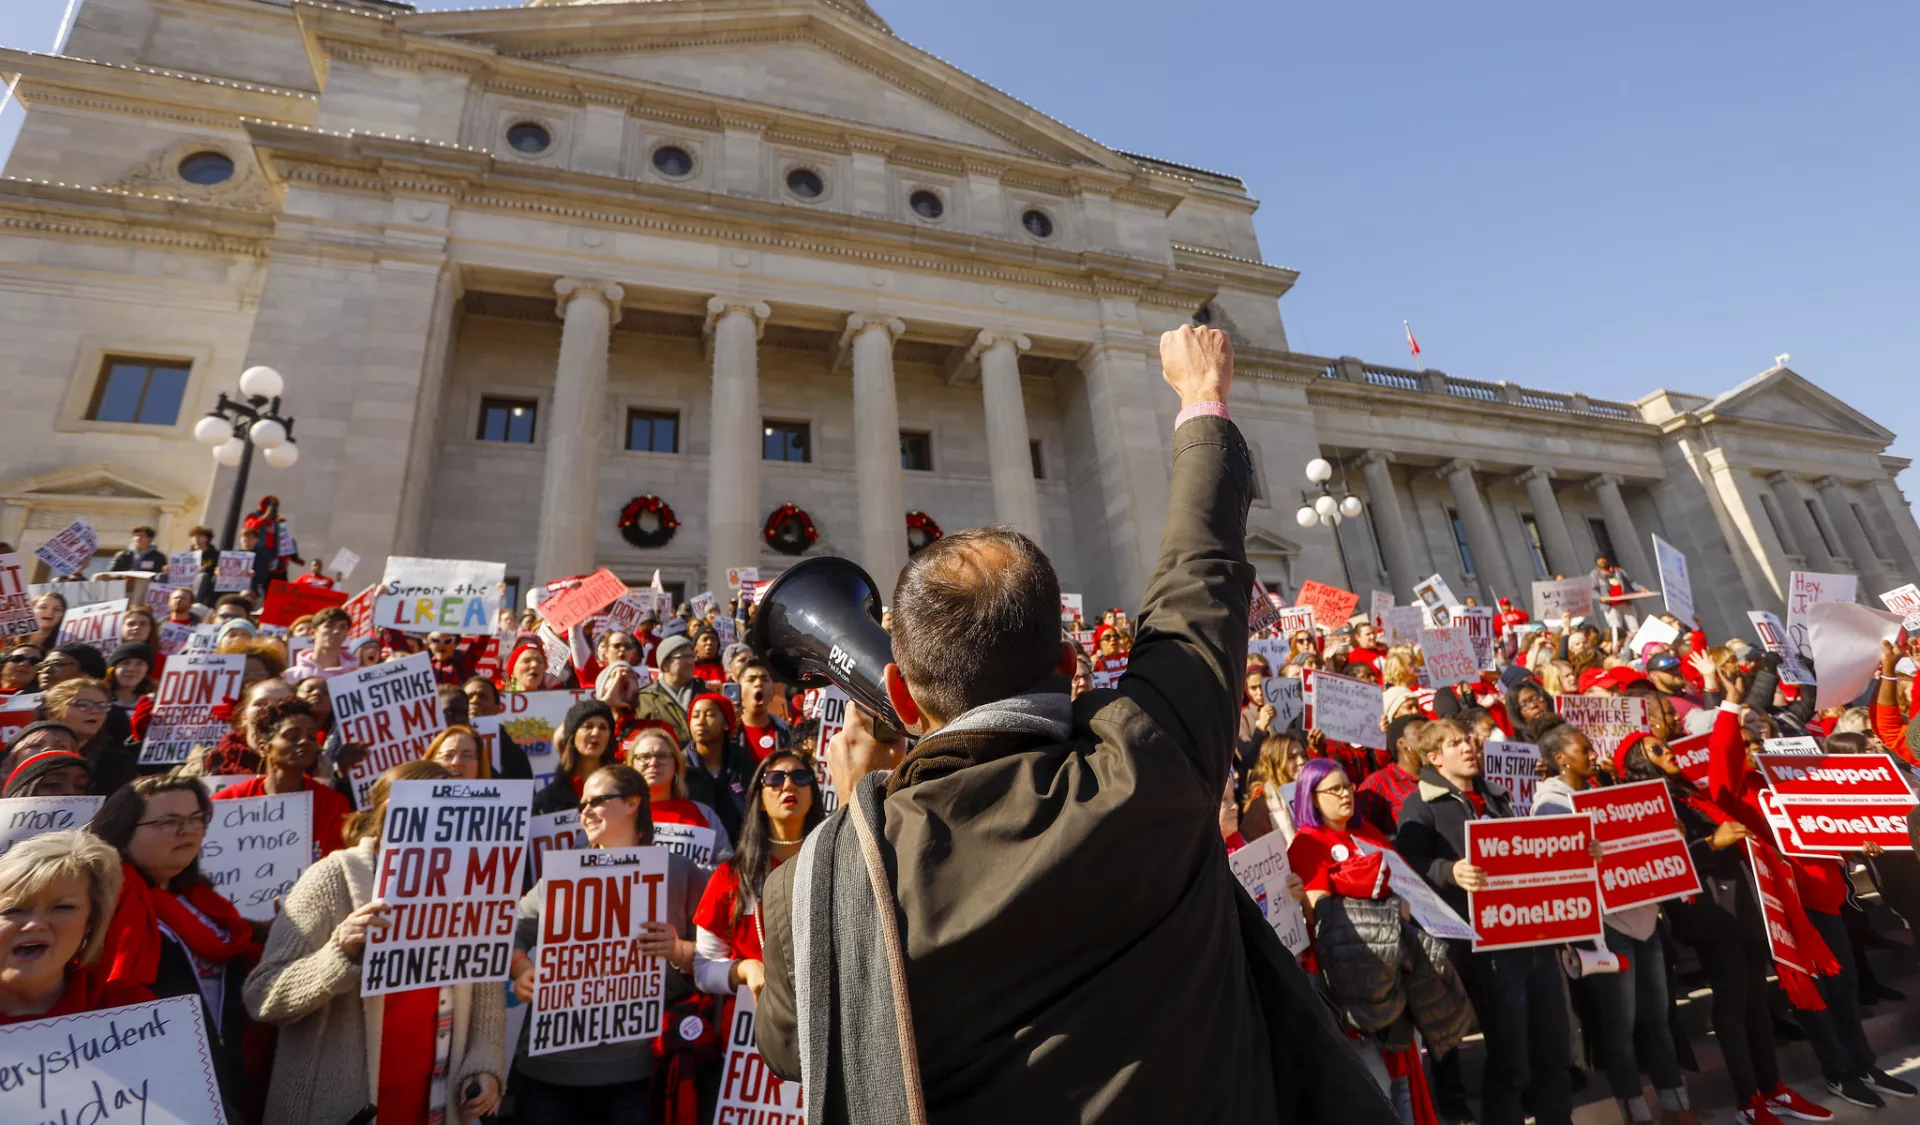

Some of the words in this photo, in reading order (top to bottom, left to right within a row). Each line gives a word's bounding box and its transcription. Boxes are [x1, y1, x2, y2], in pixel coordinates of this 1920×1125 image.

[455, 584, 488, 596] the
[394, 597, 488, 628] LREA
[1249, 609, 1281, 634] NELRSD
[1282, 613, 1314, 631] DON'T
[1432, 659, 1477, 681] VOICES
[160, 667, 241, 705] DON'T
[336, 689, 365, 719] ON
[368, 670, 436, 709] STRIKE
[1563, 697, 1631, 711] INJUSTICE
[1564, 709, 1632, 725] ANYWHERE
[342, 710, 396, 748] FOR
[399, 696, 439, 737] MY
[352, 729, 443, 780] STUDENT
[1486, 755, 1502, 774] ON
[1506, 756, 1539, 777] STRIK
[1770, 765, 1809, 781] We
[1809, 765, 1893, 786] Support
[432, 785, 472, 798] LREA
[9, 809, 76, 830] more
[223, 800, 285, 828] child
[1606, 796, 1666, 823] Support
[387, 807, 429, 843] ON
[435, 806, 528, 842] STRIKE
[1796, 815, 1910, 834] #OneLRS
[238, 829, 301, 852] more
[1478, 837, 1510, 858] We
[1512, 831, 1585, 859] Support
[255, 862, 275, 879] a
[378, 847, 453, 899] FOR
[463, 846, 524, 897] MY
[580, 854, 616, 868] LREA
[1602, 855, 1688, 892] #OneLRSD
[371, 900, 516, 944] STUDENTS
[543, 871, 665, 945] DON'T
[1481, 896, 1593, 929] #OneLRSD
[1769, 919, 1797, 950] #One
[366, 942, 510, 991] #ONELRSD
[537, 982, 574, 1013] OUR
[581, 973, 661, 1006] SCHOOLS
[534, 1000, 660, 1051] #ONELRSD
[734, 1010, 756, 1048] O
